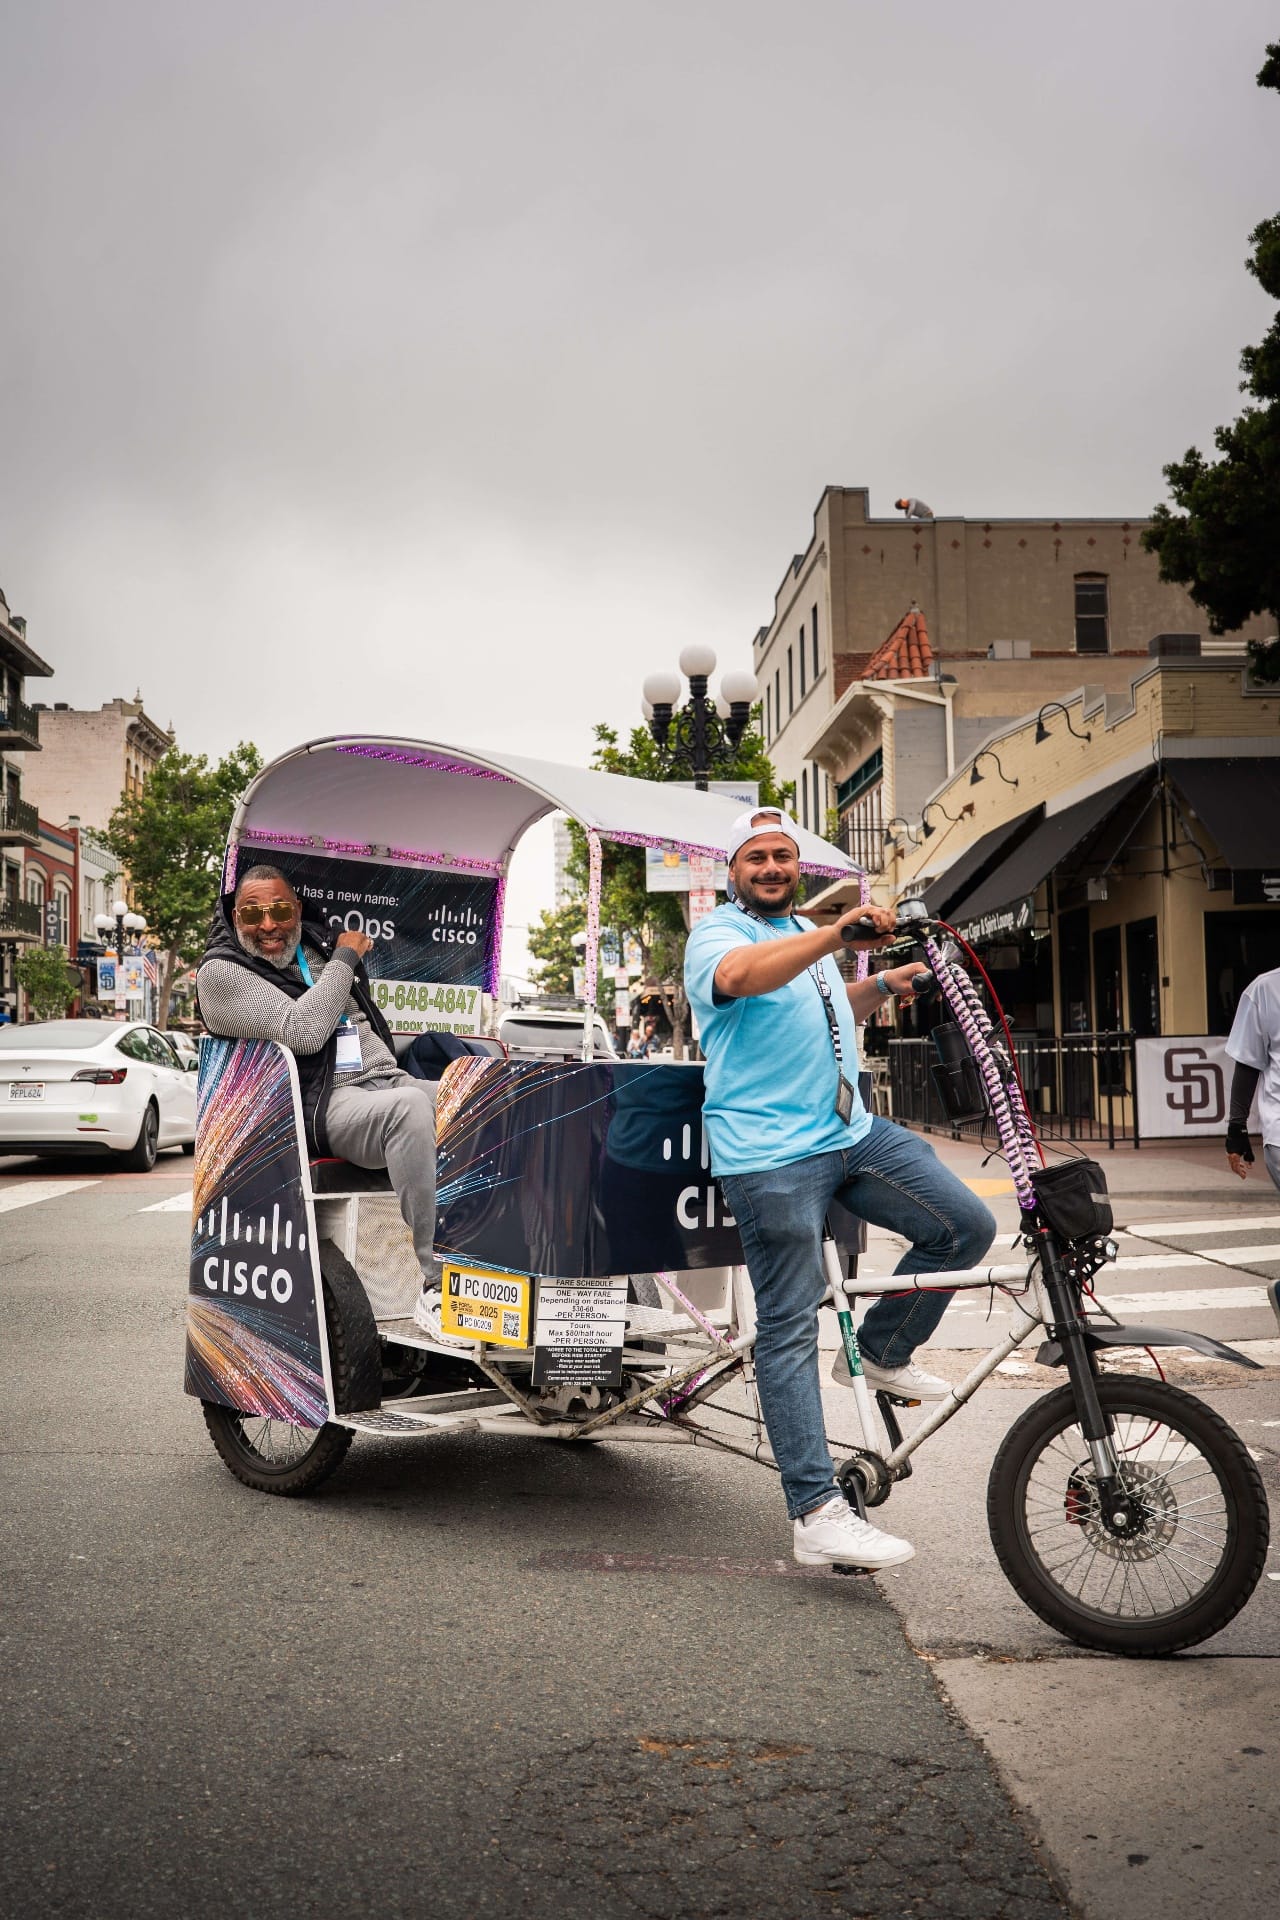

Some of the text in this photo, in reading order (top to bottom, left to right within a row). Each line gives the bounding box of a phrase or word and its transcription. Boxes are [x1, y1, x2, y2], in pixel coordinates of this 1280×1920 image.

[303, 884, 324, 899] has
[327, 890, 334, 900] a
[337, 891, 361, 903] new
[364, 894, 399, 907] name:
[432, 928, 477, 944] CISCO
[396, 1021, 424, 1033] BOOK
[426, 1021, 452, 1033] YOUR
[454, 1024, 475, 1035] RIDE
[203, 1256, 293, 1304] CISCO
[465, 1279, 480, 1297] PC
[482, 1282, 518, 1304] 00209
[540, 1296, 580, 1305] Depending
[480, 1305, 498, 1319] 2025
